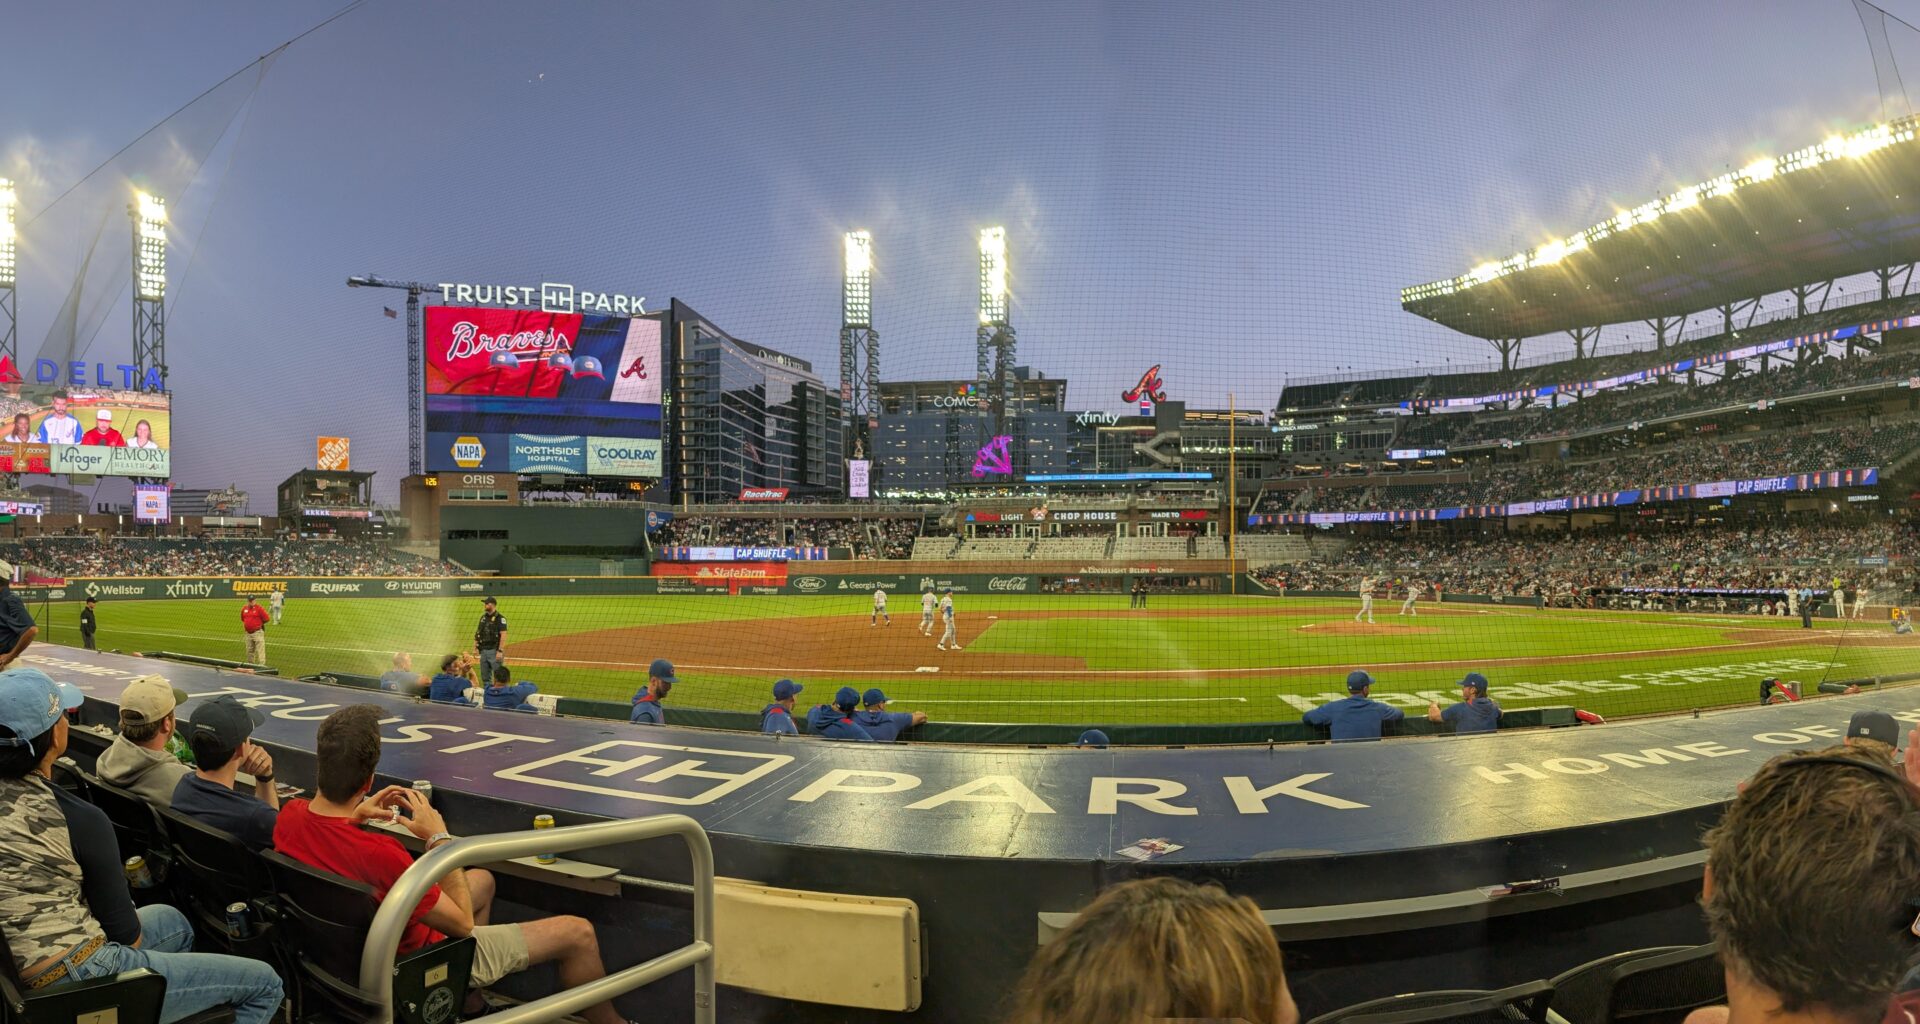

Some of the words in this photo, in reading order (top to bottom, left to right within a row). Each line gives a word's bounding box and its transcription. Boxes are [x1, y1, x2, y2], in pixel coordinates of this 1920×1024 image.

[438, 283, 535, 306] TRUIST
[581, 292, 646, 315] PARK
[447, 321, 555, 361] Braves
[36, 358, 165, 391] DELTA
[1075, 411, 1120, 426] xfinity
[114, 446, 167, 462] EMORY
[457, 446, 480, 458] NAPA
[515, 446, 581, 456] NORTHSIDE
[597, 447, 657, 461] COOLRAY
[60, 447, 102, 471] Kroger
[462, 474, 495, 485] ORIS
[1738, 481, 1752, 492] CAP
[1754, 478, 1787, 491] SHUFFLE
[1536, 500, 1545, 511] CAP
[1546, 498, 1567, 510] SHUFFLE
[1000, 513, 1024, 521] LIGHT
[1084, 512, 1117, 520] HOUSE
[1359, 512, 1387, 521] SHUFFLE
[737, 549, 751, 558] CAP
[753, 549, 787, 558] SHUFFLE
[166, 580, 213, 597] xfinity
[232, 581, 287, 592] QUIKRETE
[310, 583, 360, 595] EQUIFAX
[402, 582, 441, 590] HYUNDAI
[799, 578, 821, 588] Ford
[850, 582, 876, 590] Georgia
[877, 581, 897, 589] Power
[102, 585, 145, 595] Wellstar
[1472, 739, 1751, 785] HOME
[1752, 724, 1841, 745] OF
[797, 769, 1371, 816] PARK
